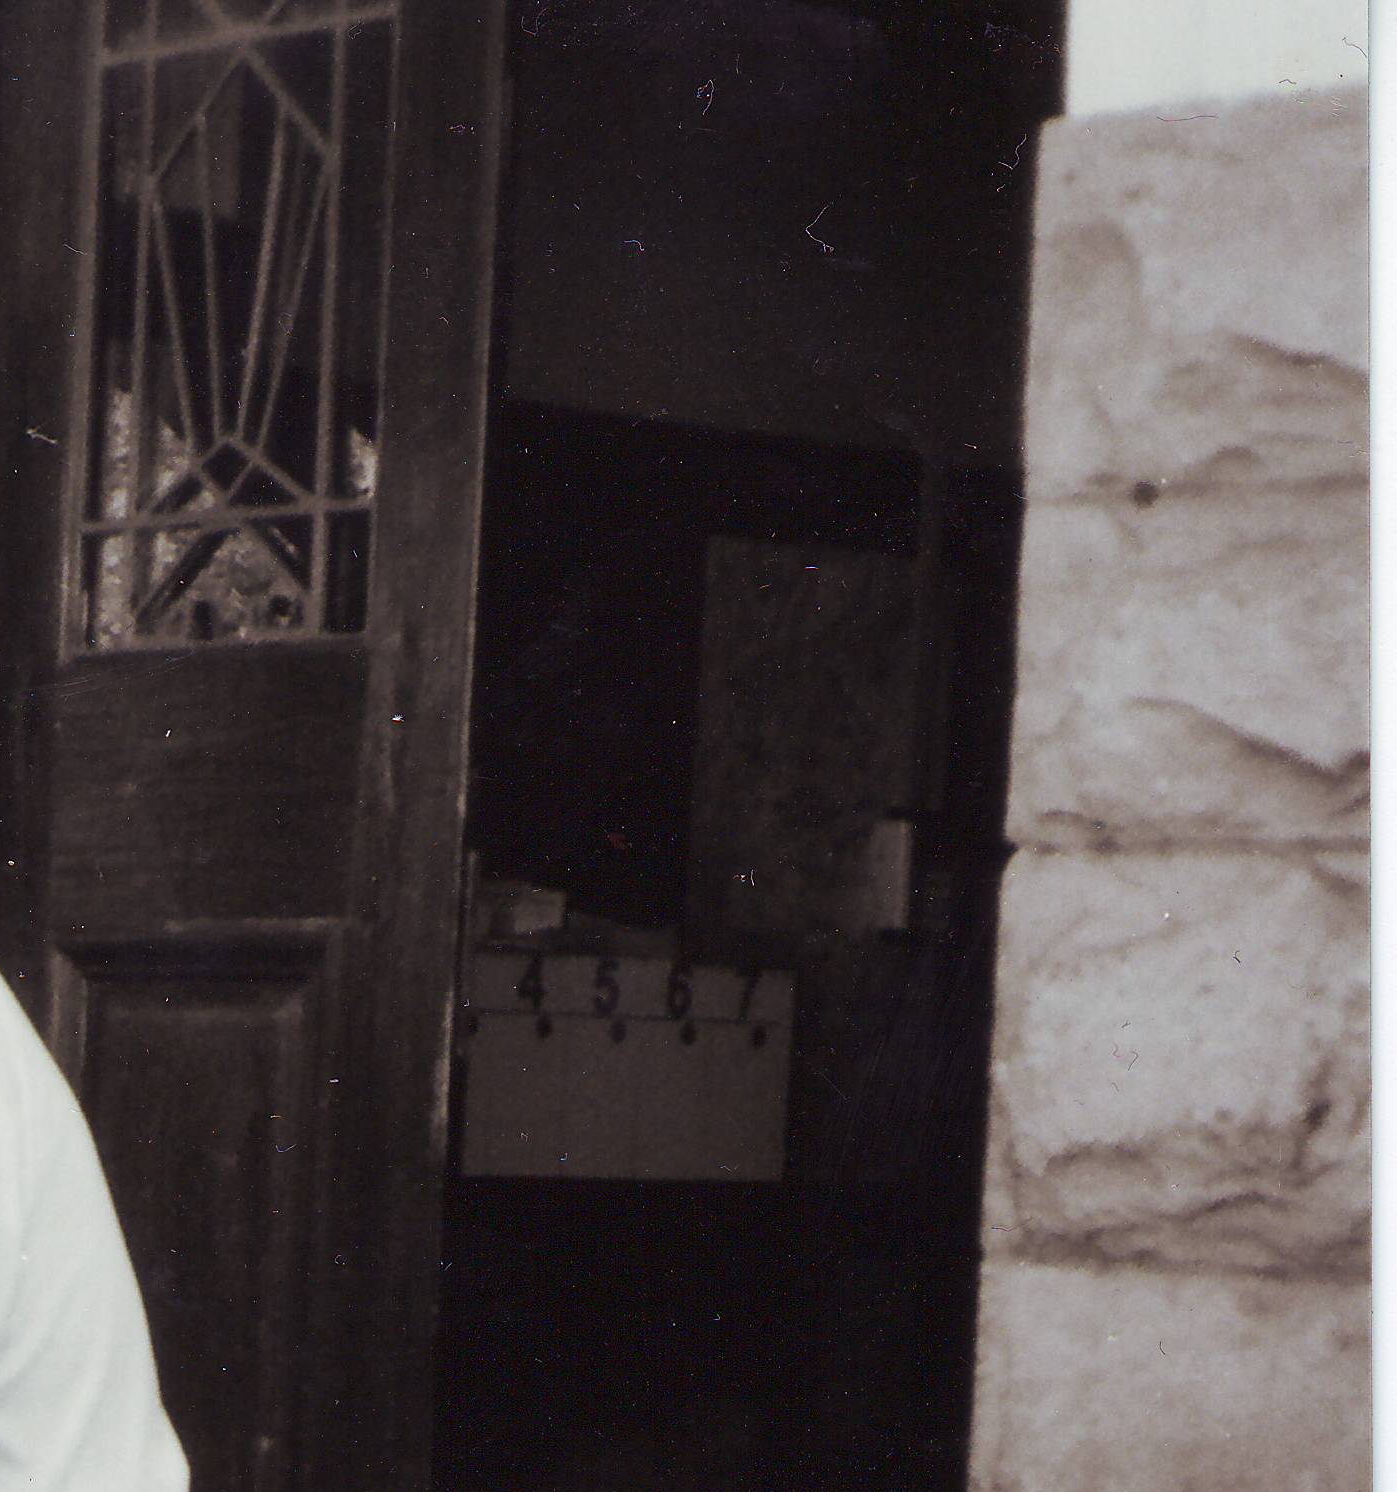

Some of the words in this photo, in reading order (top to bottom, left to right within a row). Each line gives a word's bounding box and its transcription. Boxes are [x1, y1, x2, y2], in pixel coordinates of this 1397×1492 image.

[518, 950, 545, 1012] 4
[593, 956, 619, 1017] 5
[667, 957, 693, 1018] 6
